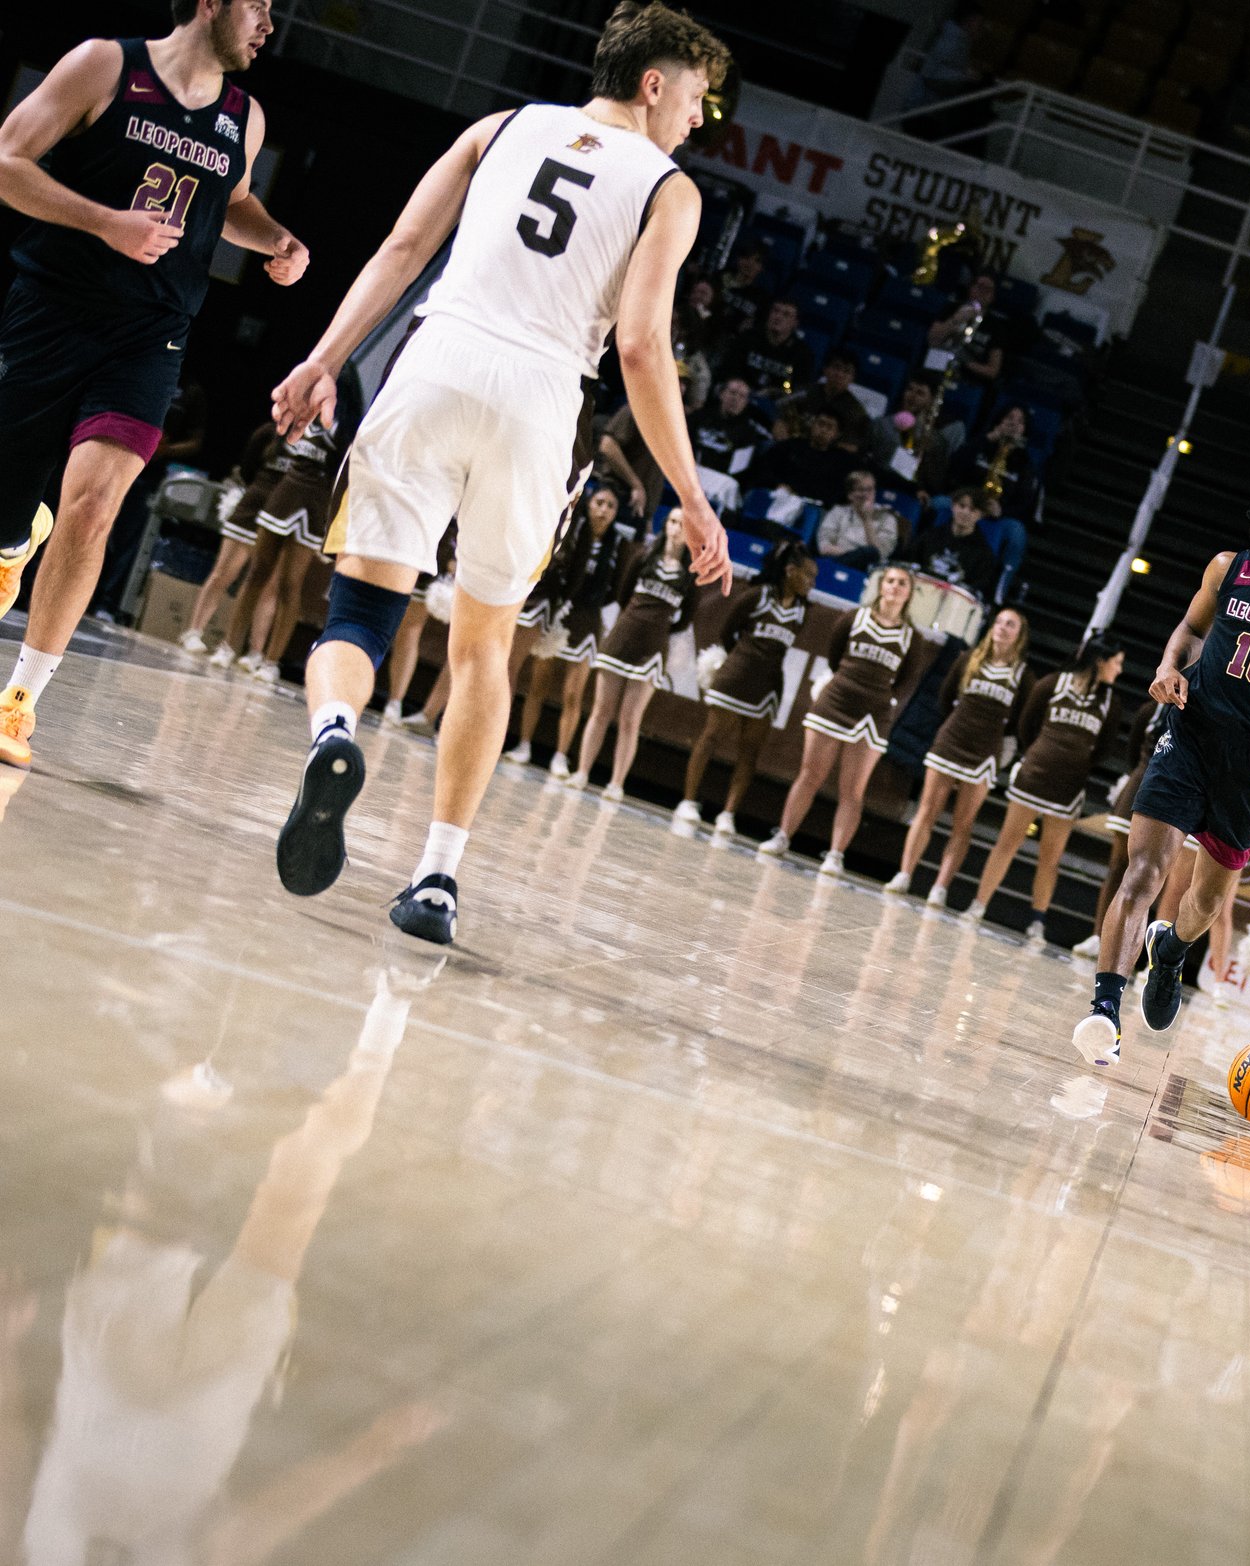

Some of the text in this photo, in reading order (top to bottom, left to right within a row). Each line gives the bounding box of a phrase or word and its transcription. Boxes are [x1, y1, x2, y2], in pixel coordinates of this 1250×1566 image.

[125, 115, 230, 177] LEOPARDS
[130, 162, 200, 231] 21
[516, 157, 595, 258] 5
[849, 641, 902, 672] LEHIGH
[1050, 706, 1102, 736] LEHIGH
